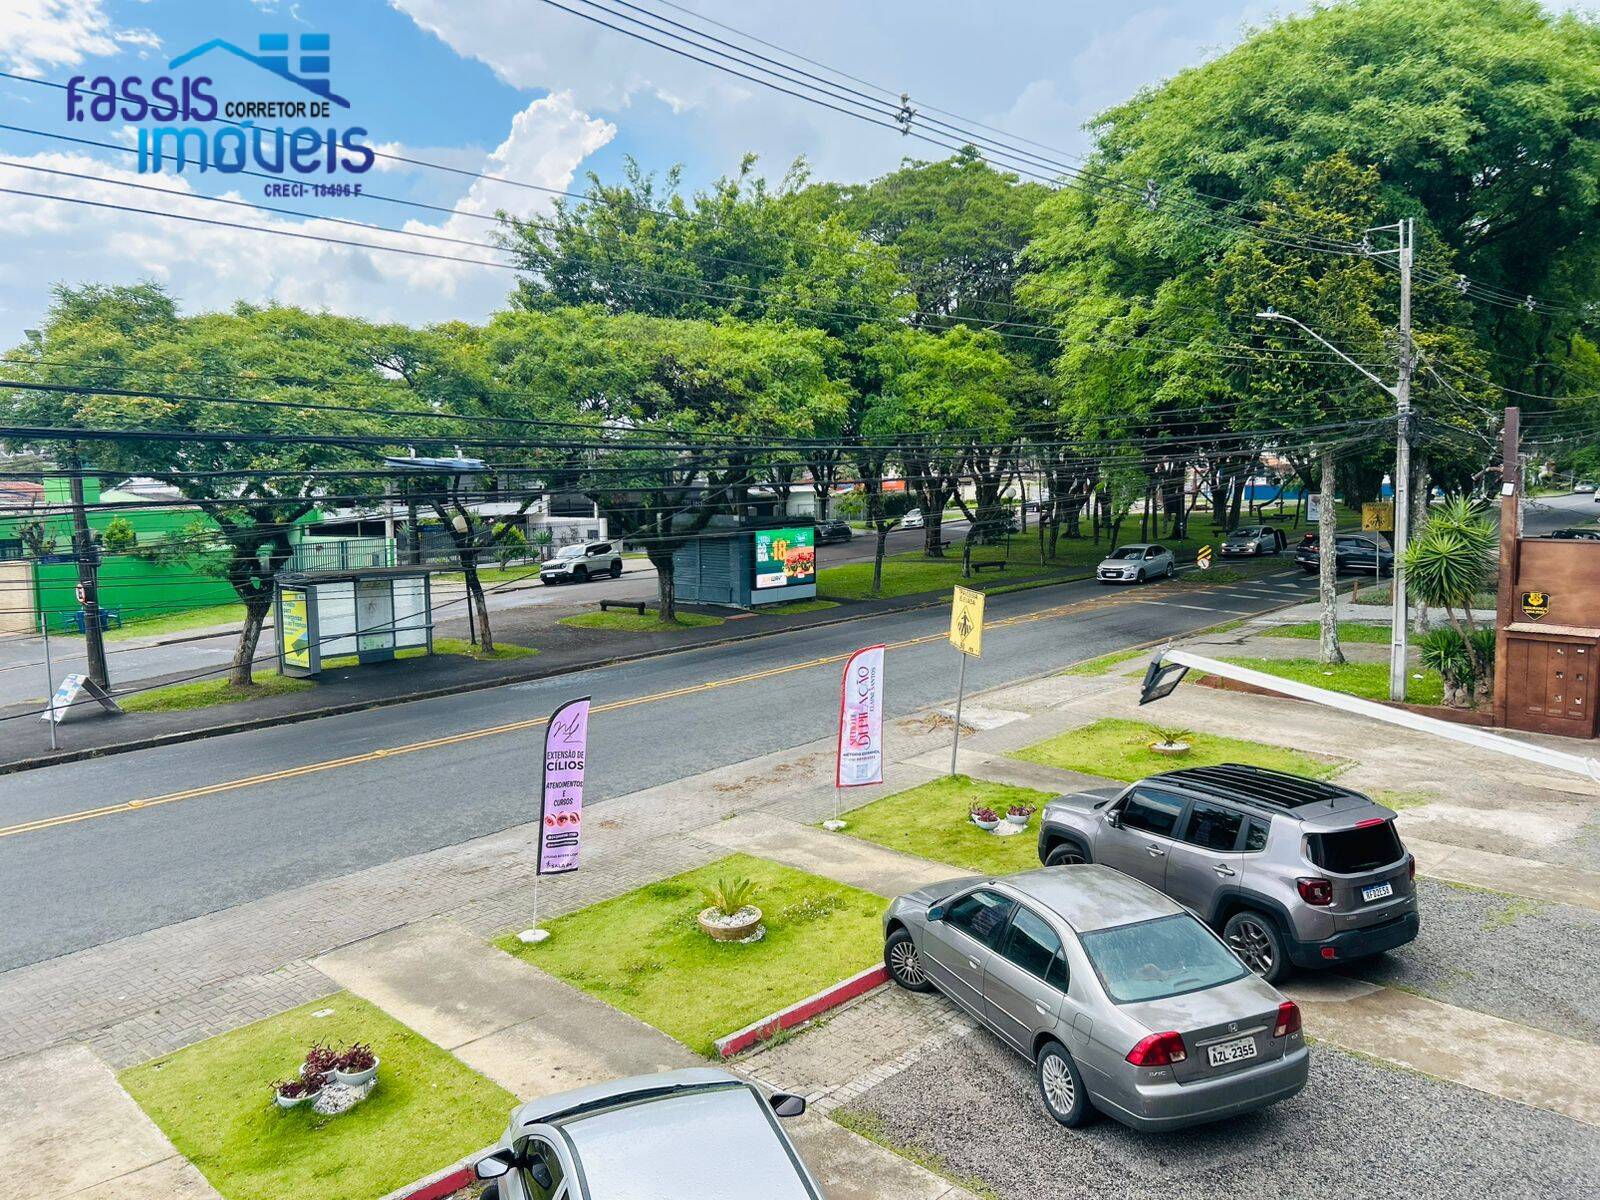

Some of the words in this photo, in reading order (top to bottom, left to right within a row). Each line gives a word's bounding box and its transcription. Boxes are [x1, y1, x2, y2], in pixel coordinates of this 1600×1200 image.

[547, 749, 577, 759] EXTENSÃO
[577, 750, 584, 759] DE
[546, 758, 584, 771] CÍLIOS
[545, 780, 583, 789] ATENDIMENTOS
[553, 797, 573, 807] CURSOS
